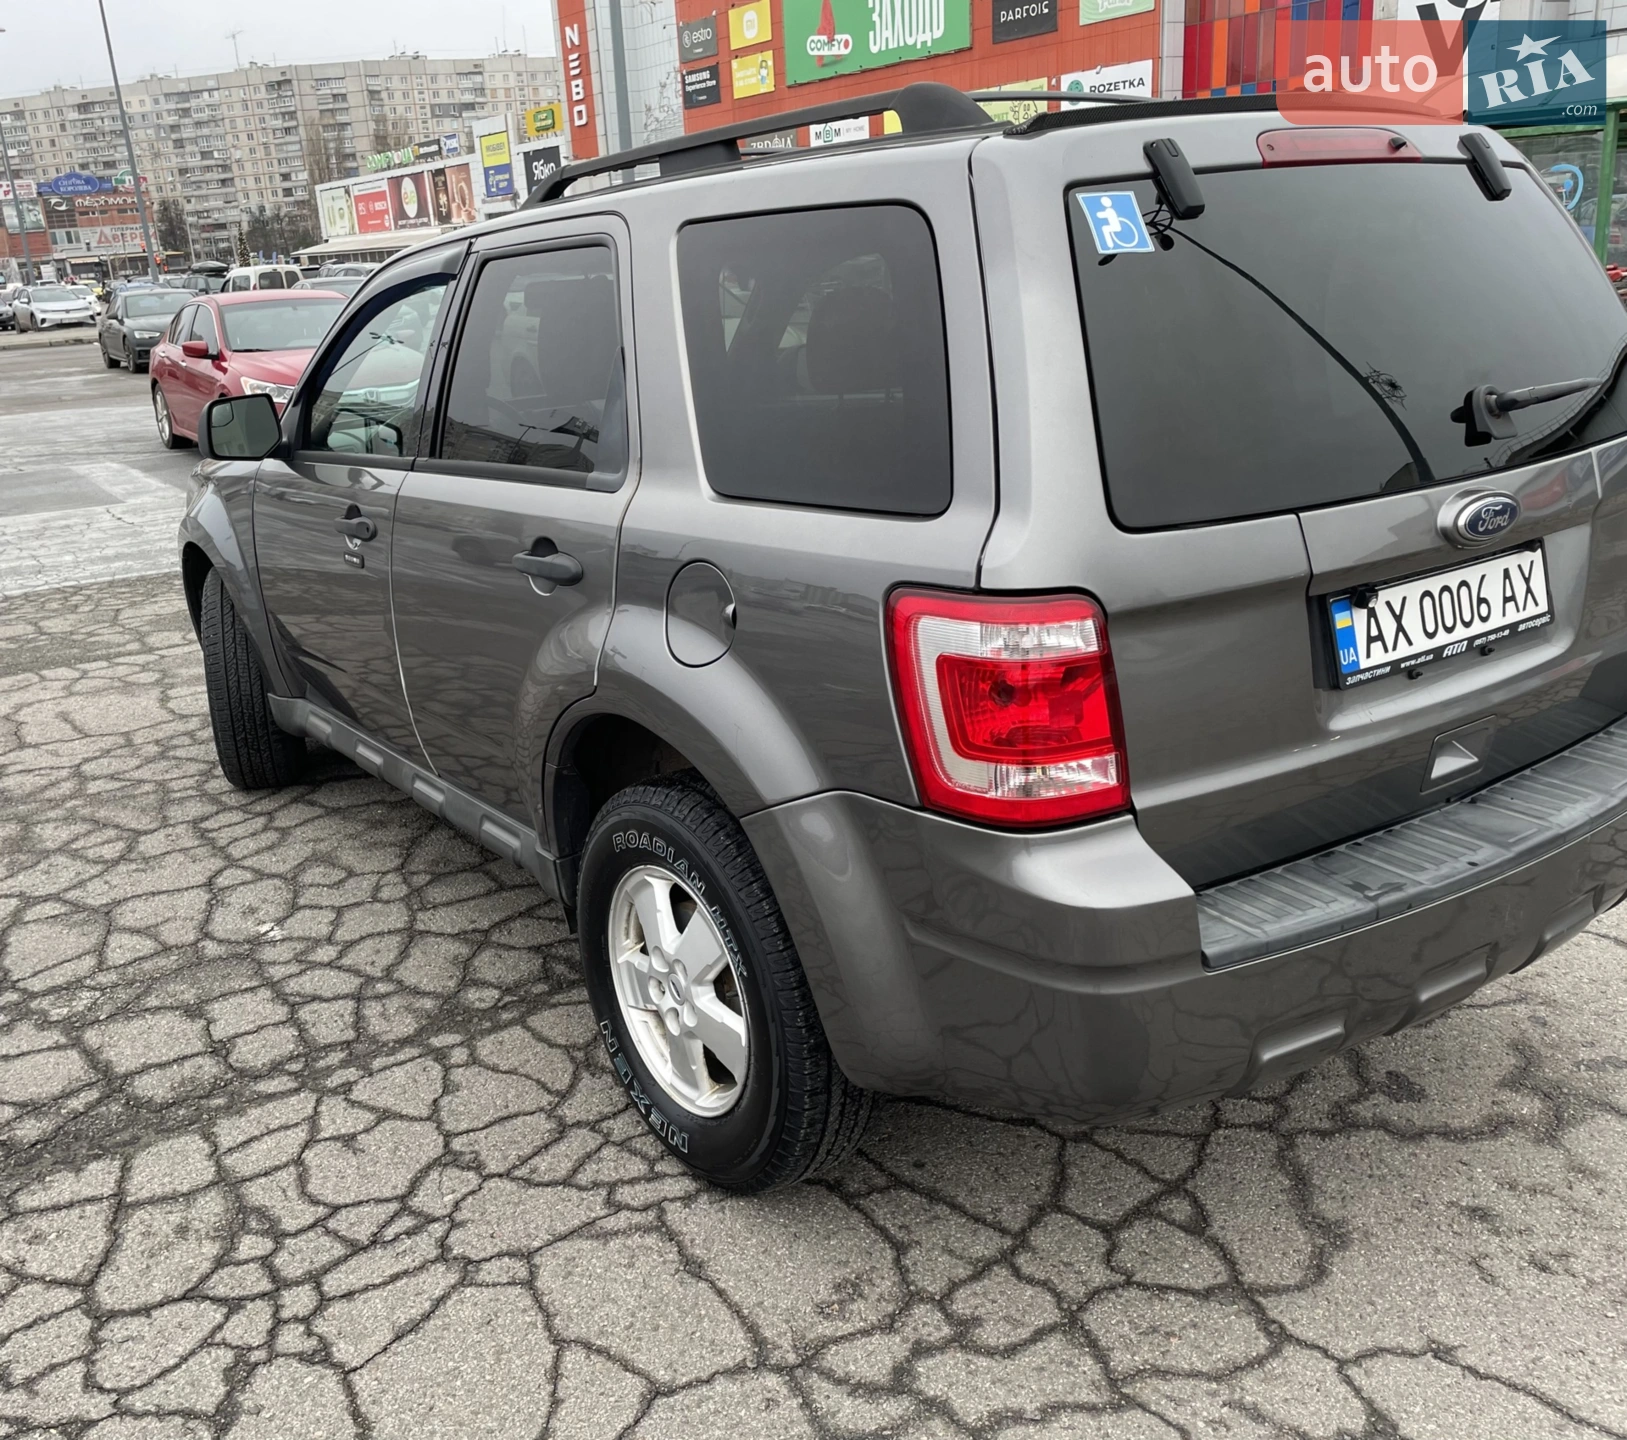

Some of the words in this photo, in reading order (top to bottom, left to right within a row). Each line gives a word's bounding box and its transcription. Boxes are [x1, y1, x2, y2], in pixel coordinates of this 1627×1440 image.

[1000, 1, 1050, 23] PARFOIS
[691, 27, 712, 43] estro
[808, 38, 843, 52] COMFY
[684, 70, 711, 84] SAMSUNG
[1089, 77, 1145, 94] ROZETKA
[532, 159, 556, 181] Ябко
[1478, 504, 1511, 532] Ford
[1365, 595, 1414, 659] AX
[1419, 573, 1492, 640] 0006
[1502, 560, 1539, 618] AX
[1340, 647, 1358, 666] UA
[613, 830, 706, 896] ROADIAN
[600, 1019, 690, 1153] NEXEN
